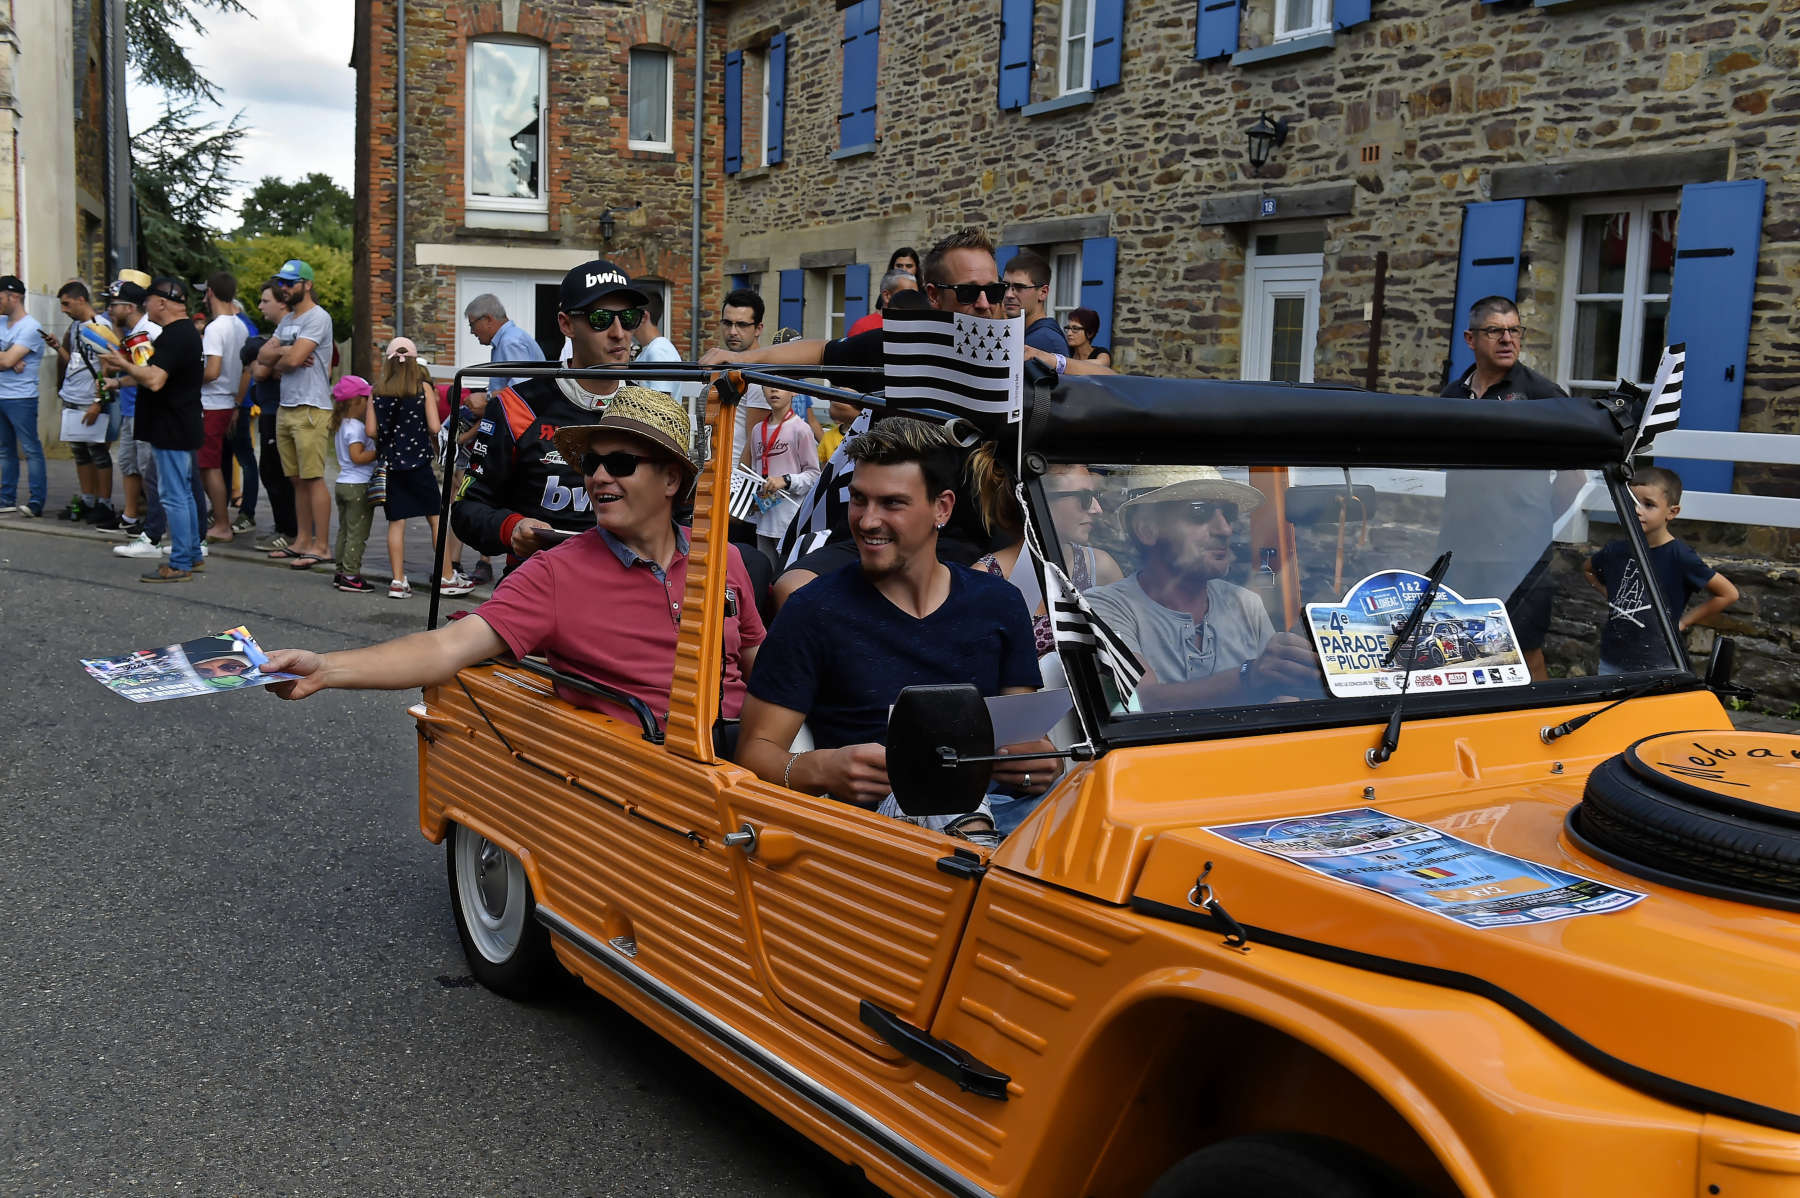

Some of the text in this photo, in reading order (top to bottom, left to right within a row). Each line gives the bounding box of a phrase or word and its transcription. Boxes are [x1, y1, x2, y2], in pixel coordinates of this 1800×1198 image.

[585, 270, 628, 288] bwin
[1406, 583, 1414, 592] &
[1413, 581, 1422, 591] 2
[1320, 634, 1389, 654] PARADE
